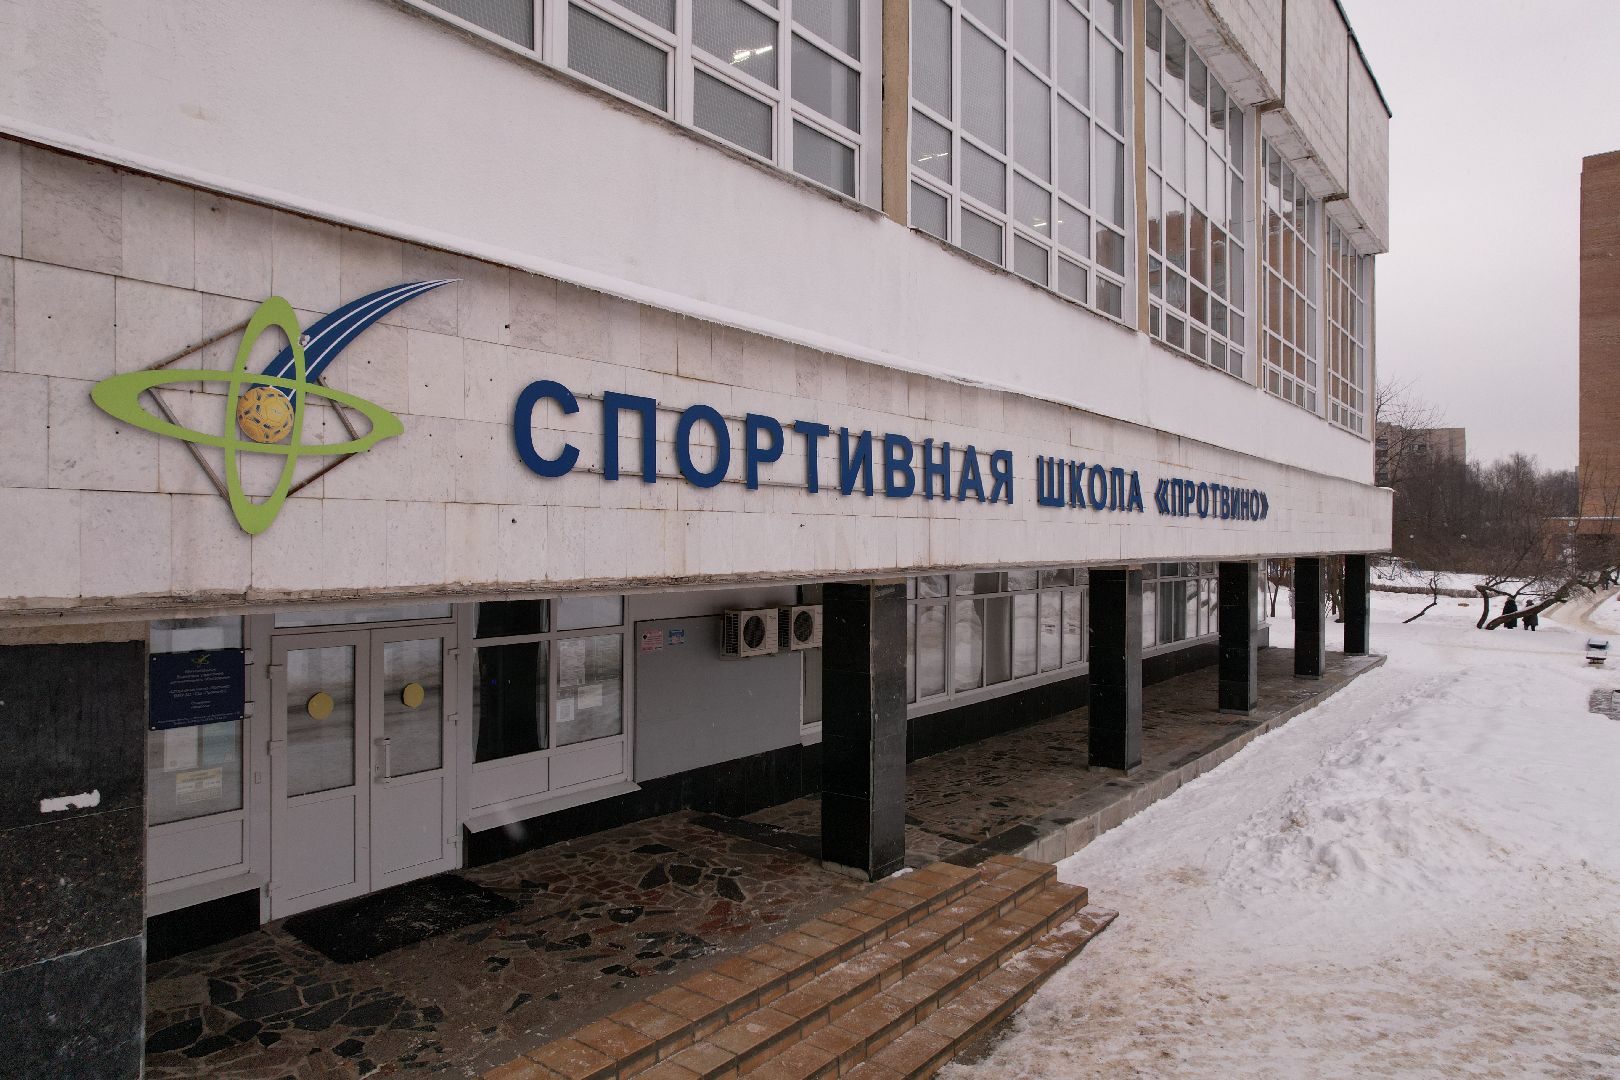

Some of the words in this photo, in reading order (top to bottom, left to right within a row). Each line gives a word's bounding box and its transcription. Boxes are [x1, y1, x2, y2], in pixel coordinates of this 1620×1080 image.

[514, 380, 1014, 505] СПОРТИВНАЯ
[1038, 455, 1144, 513] ШКОЛА
[1154, 478, 1269, 521] «ПРОТВИНО»
